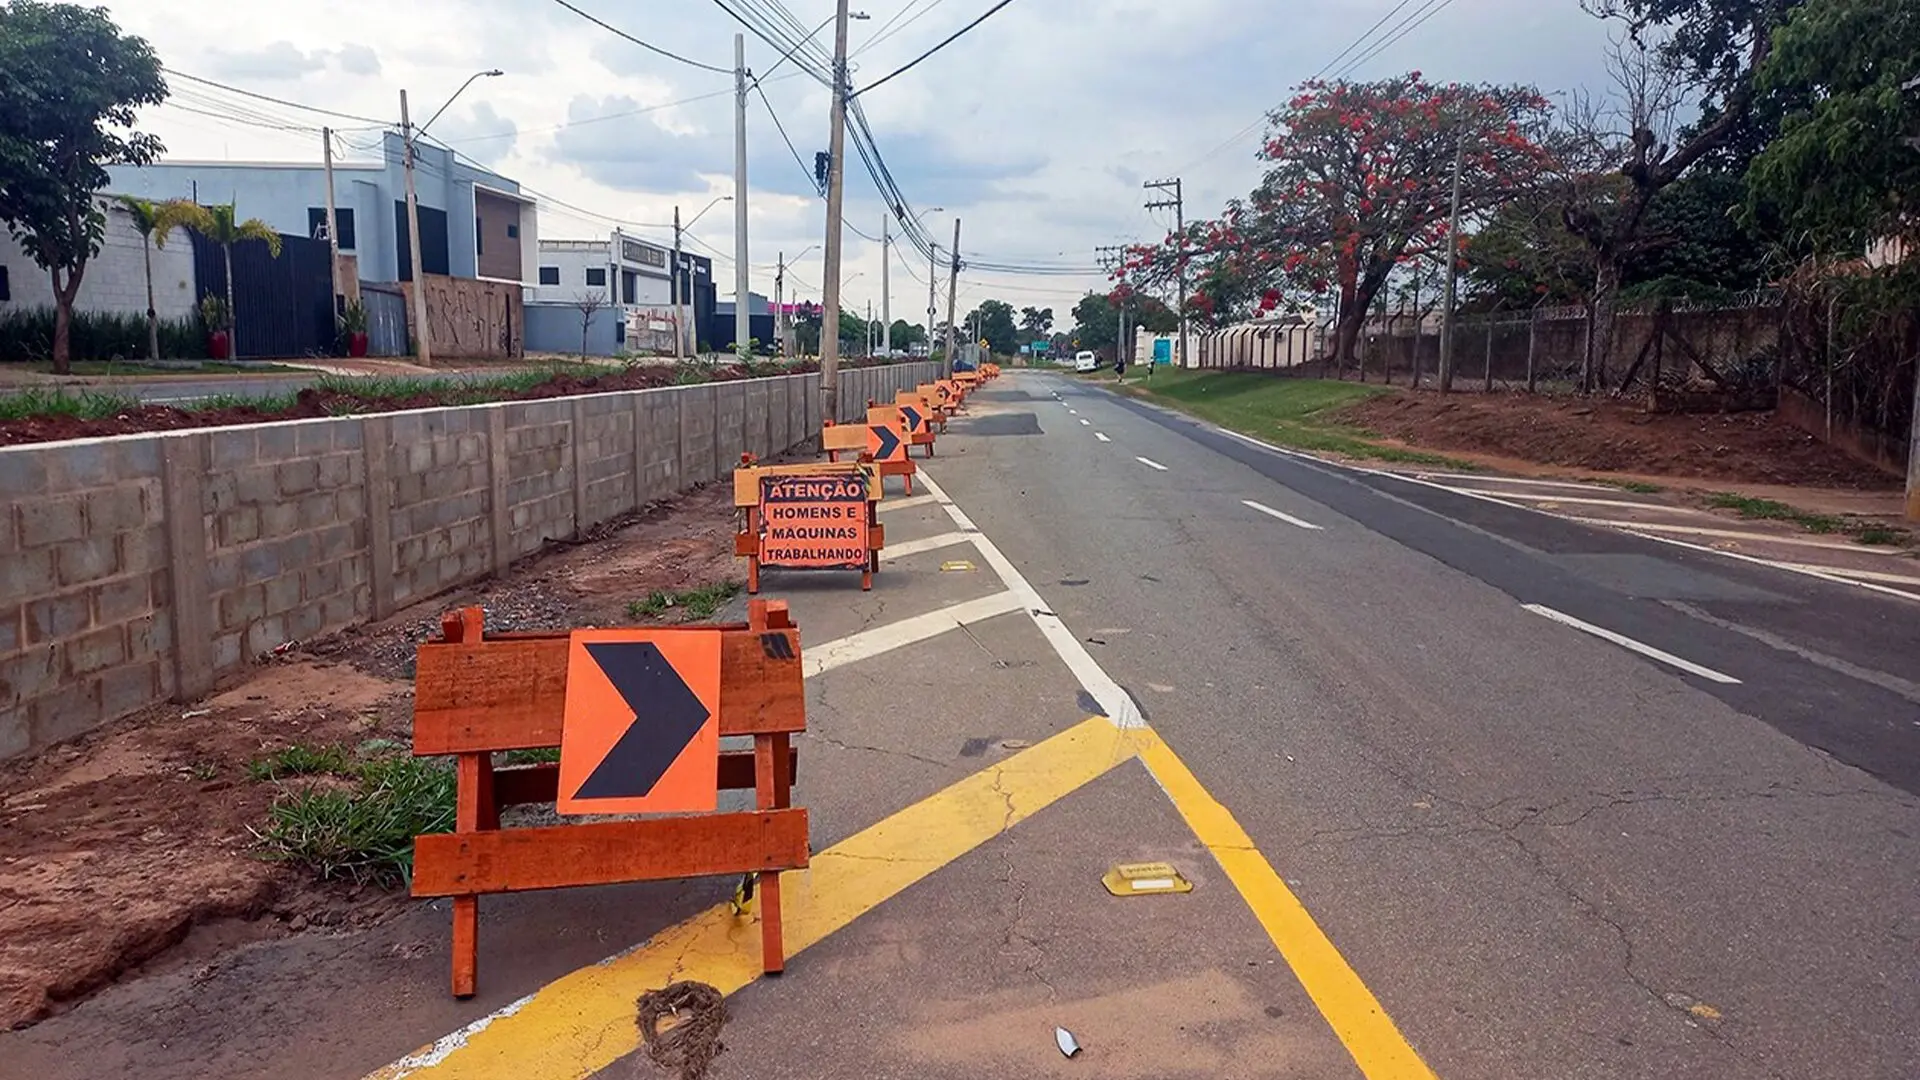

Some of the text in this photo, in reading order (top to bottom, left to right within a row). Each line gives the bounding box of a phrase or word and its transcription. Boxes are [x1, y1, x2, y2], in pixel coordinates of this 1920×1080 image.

[769, 482, 860, 501] ATENÇÃO
[773, 507, 856, 519] HOMENS E
[767, 548, 862, 560] TRABALHANDO
